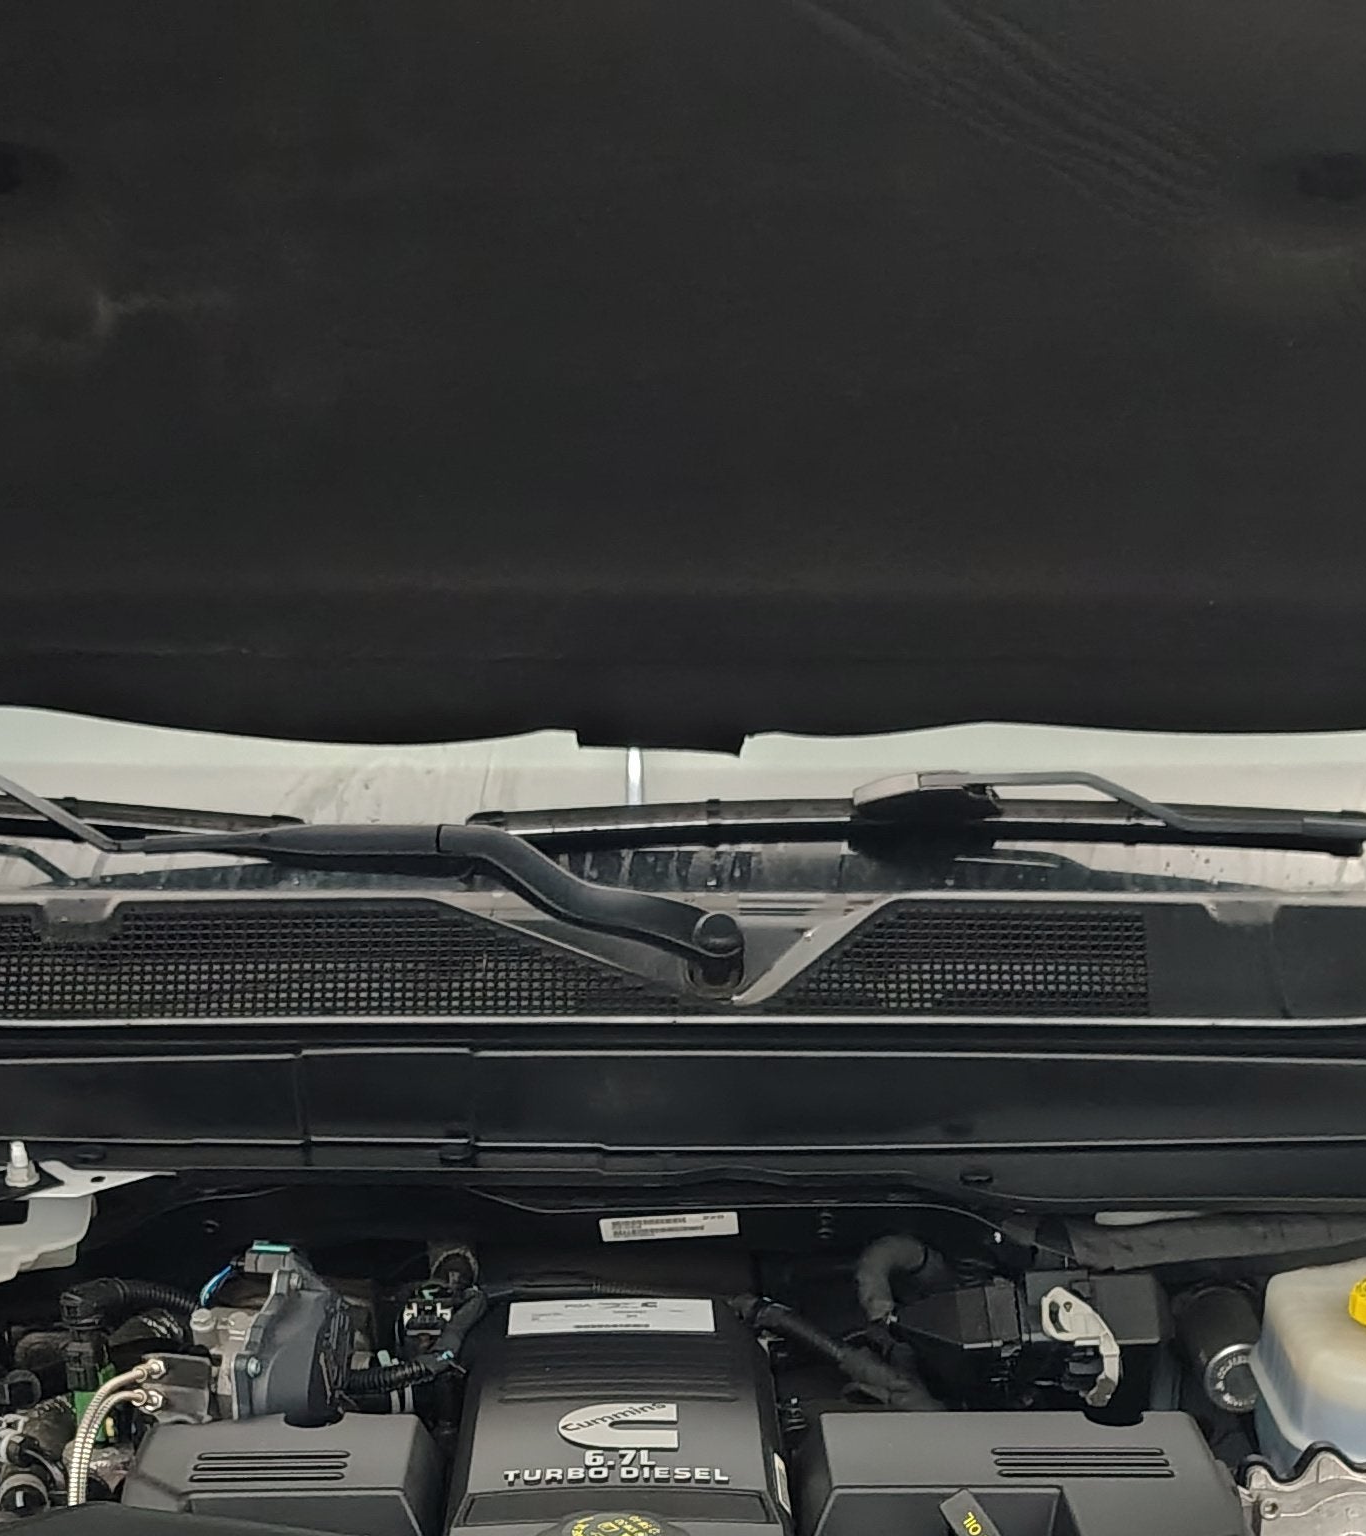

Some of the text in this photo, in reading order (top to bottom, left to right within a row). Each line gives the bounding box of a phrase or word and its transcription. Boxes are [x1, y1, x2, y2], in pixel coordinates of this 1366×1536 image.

[561, 1402, 666, 1432] Cummins
[585, 1450, 656, 1467] 6.7L
[503, 1467, 729, 1482] TURBO DIESEL
[963, 1511, 982, 1536] OIL
